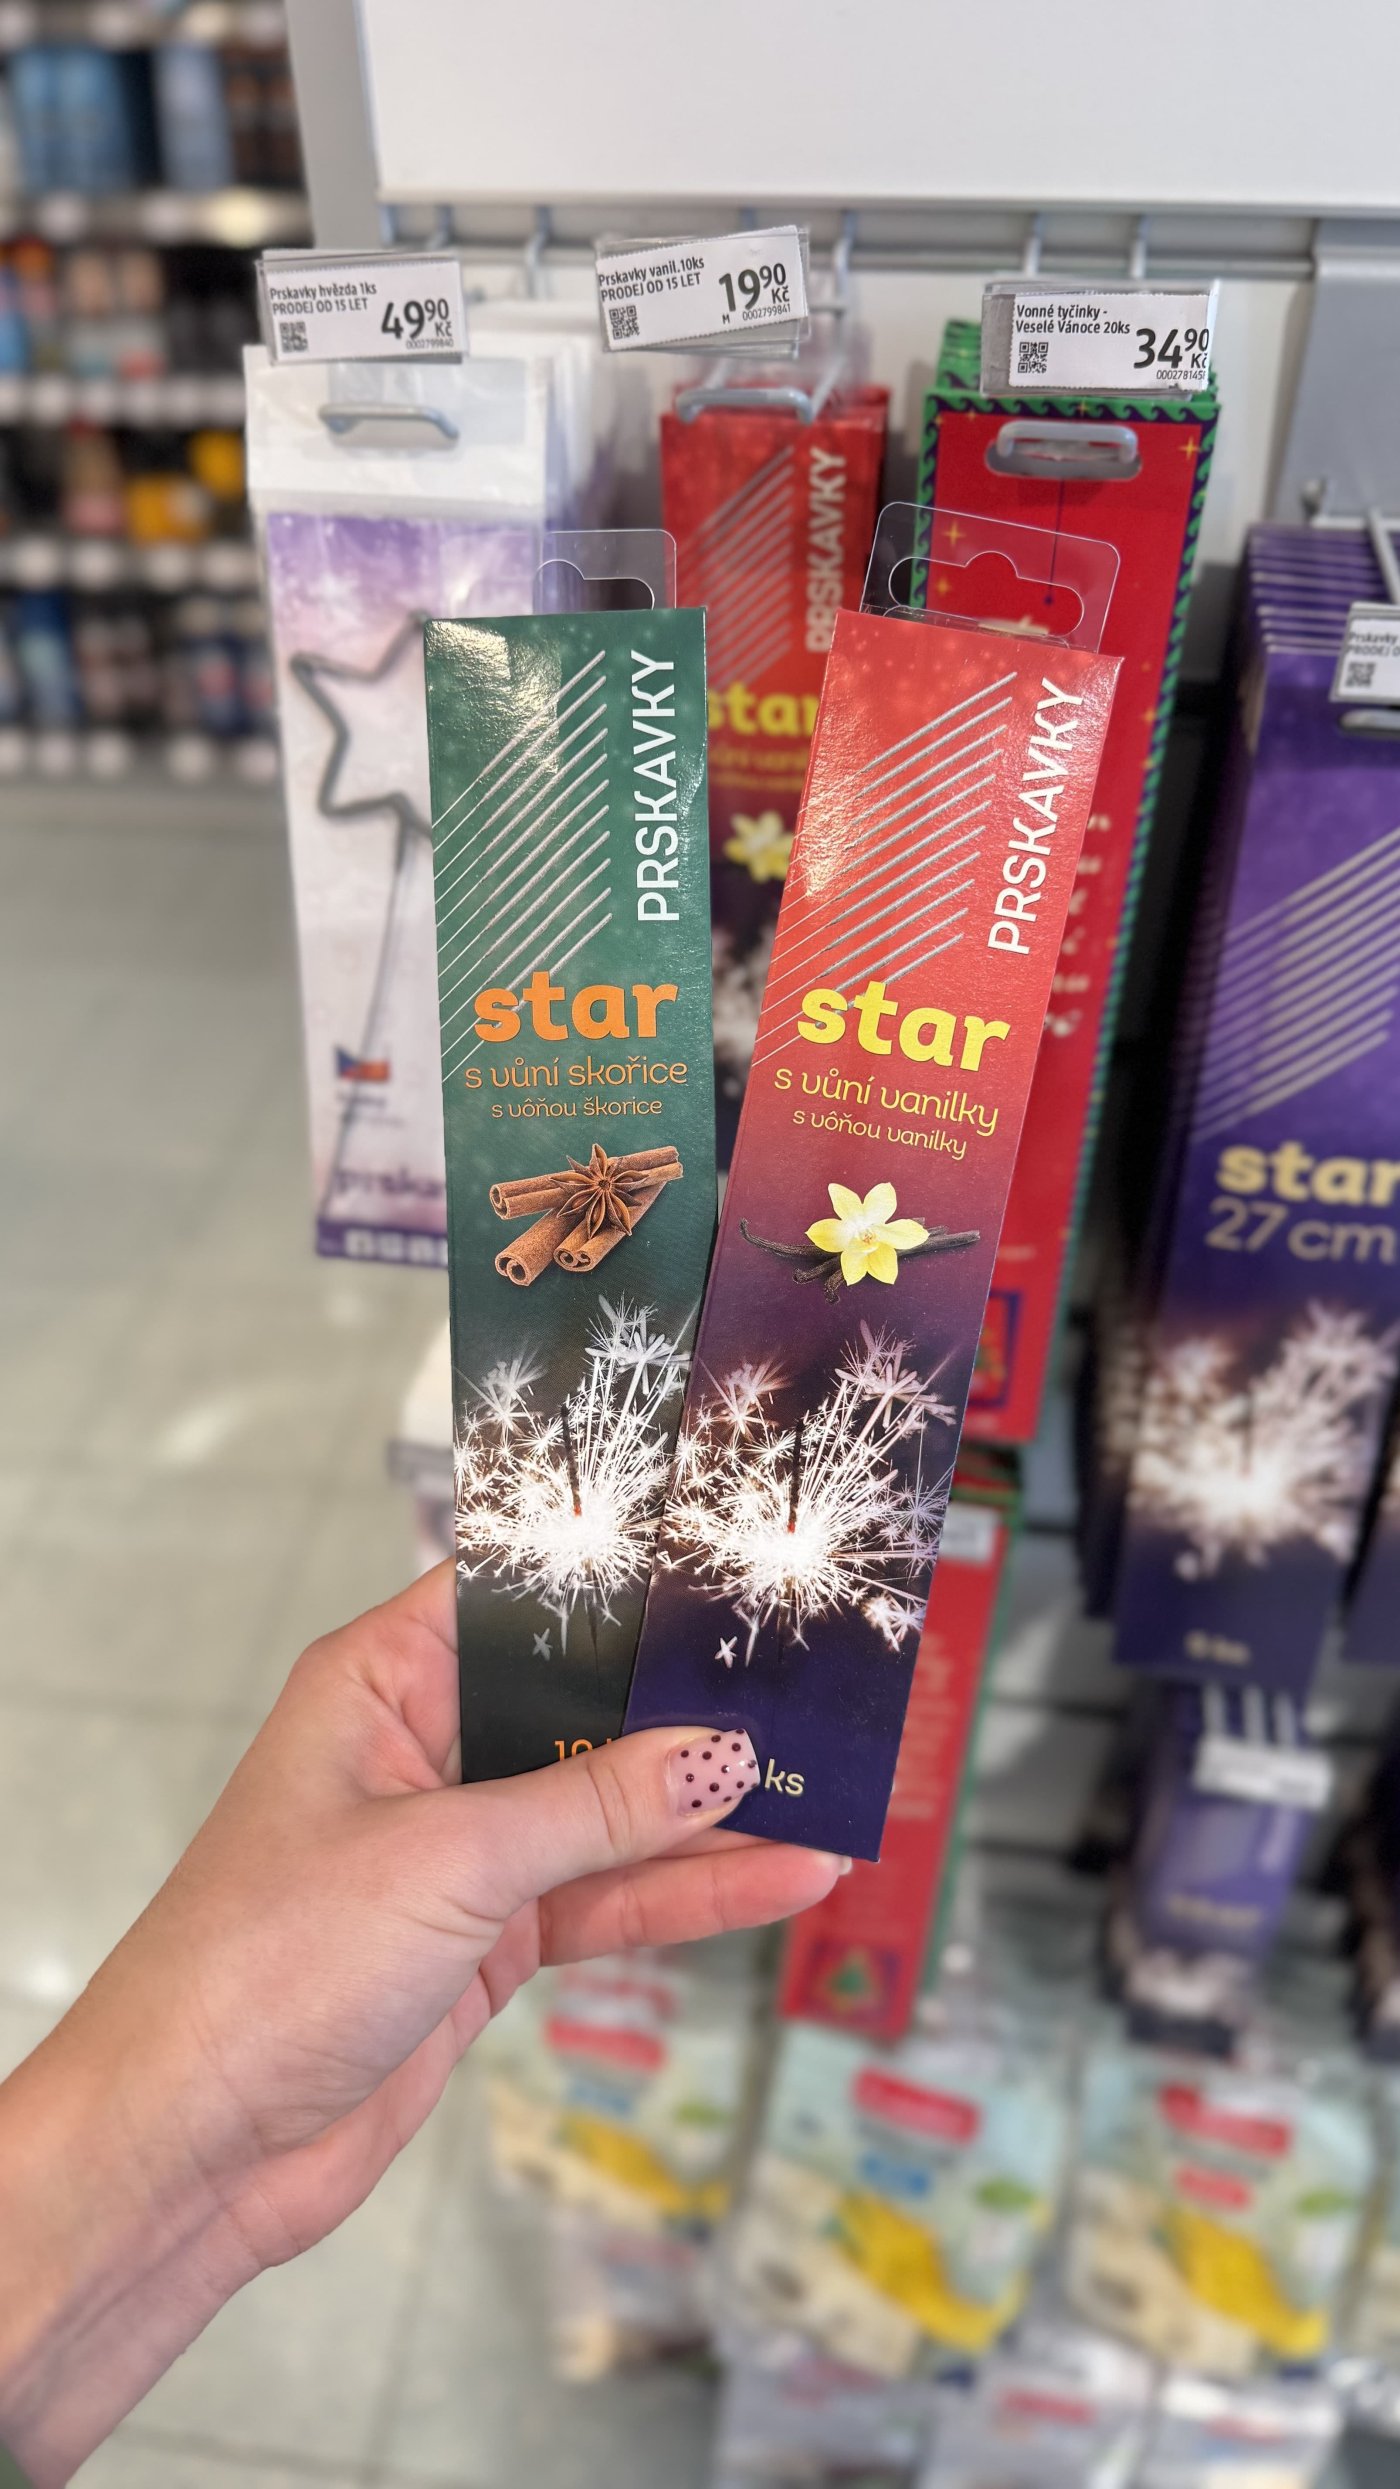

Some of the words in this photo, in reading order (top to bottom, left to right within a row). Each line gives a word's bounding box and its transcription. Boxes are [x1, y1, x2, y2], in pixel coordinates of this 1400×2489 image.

[600, 267, 647, 287] Prskavky
[601, 285, 645, 302] PRODEJ
[646, 280, 664, 294] OD
[666, 277, 678, 290] 15
[681, 272, 702, 288] LET
[269, 285, 317, 301] Prskavky
[319, 283, 358, 297] hvězda
[360, 281, 377, 295] 1ks
[771, 286, 790, 304] Kč
[272, 299, 314, 316] PRODEJ
[316, 299, 333, 314] OD
[334, 298, 347, 313] 15
[349, 297, 368, 312] LET
[742, 303, 791, 321] 0002799841
[1016, 304, 1054, 318] Vonné
[1057, 303, 1101, 322] tyčinky
[435, 320, 453, 338] Kč
[722, 313, 731, 325] M
[1015, 319, 1055, 334] Veselé
[1058, 319, 1101, 334] Vánoce
[1103, 320, 1131, 335] 20ks
[1190, 352, 1208, 369] Kč
[630, 649, 680, 921] PRSKAVKY
[987, 677, 1084, 956] PRSKAVKY
[474, 970, 679, 1042] star
[797, 980, 1011, 1072] star
[464, 1067, 483, 1089] s
[490, 1056, 560, 1088] vůní
[568, 1055, 688, 1086] skořice
[491, 1103, 504, 1118] s
[507, 1097, 577, 1118] vôňou
[583, 1095, 663, 1117] škorice
[774, 1067, 793, 1090] s
[801, 1067, 876, 1105] vůní
[880, 1086, 999, 1137] vanilky
[792, 1109, 805, 1125] s
[811, 1110, 881, 1140] vôňou
[887, 1126, 967, 1161] vanilky
[1204, 1195, 1288, 1252] 27
[1287, 1219, 1398, 1265] cm
[764, 1758, 805, 1796] ks
